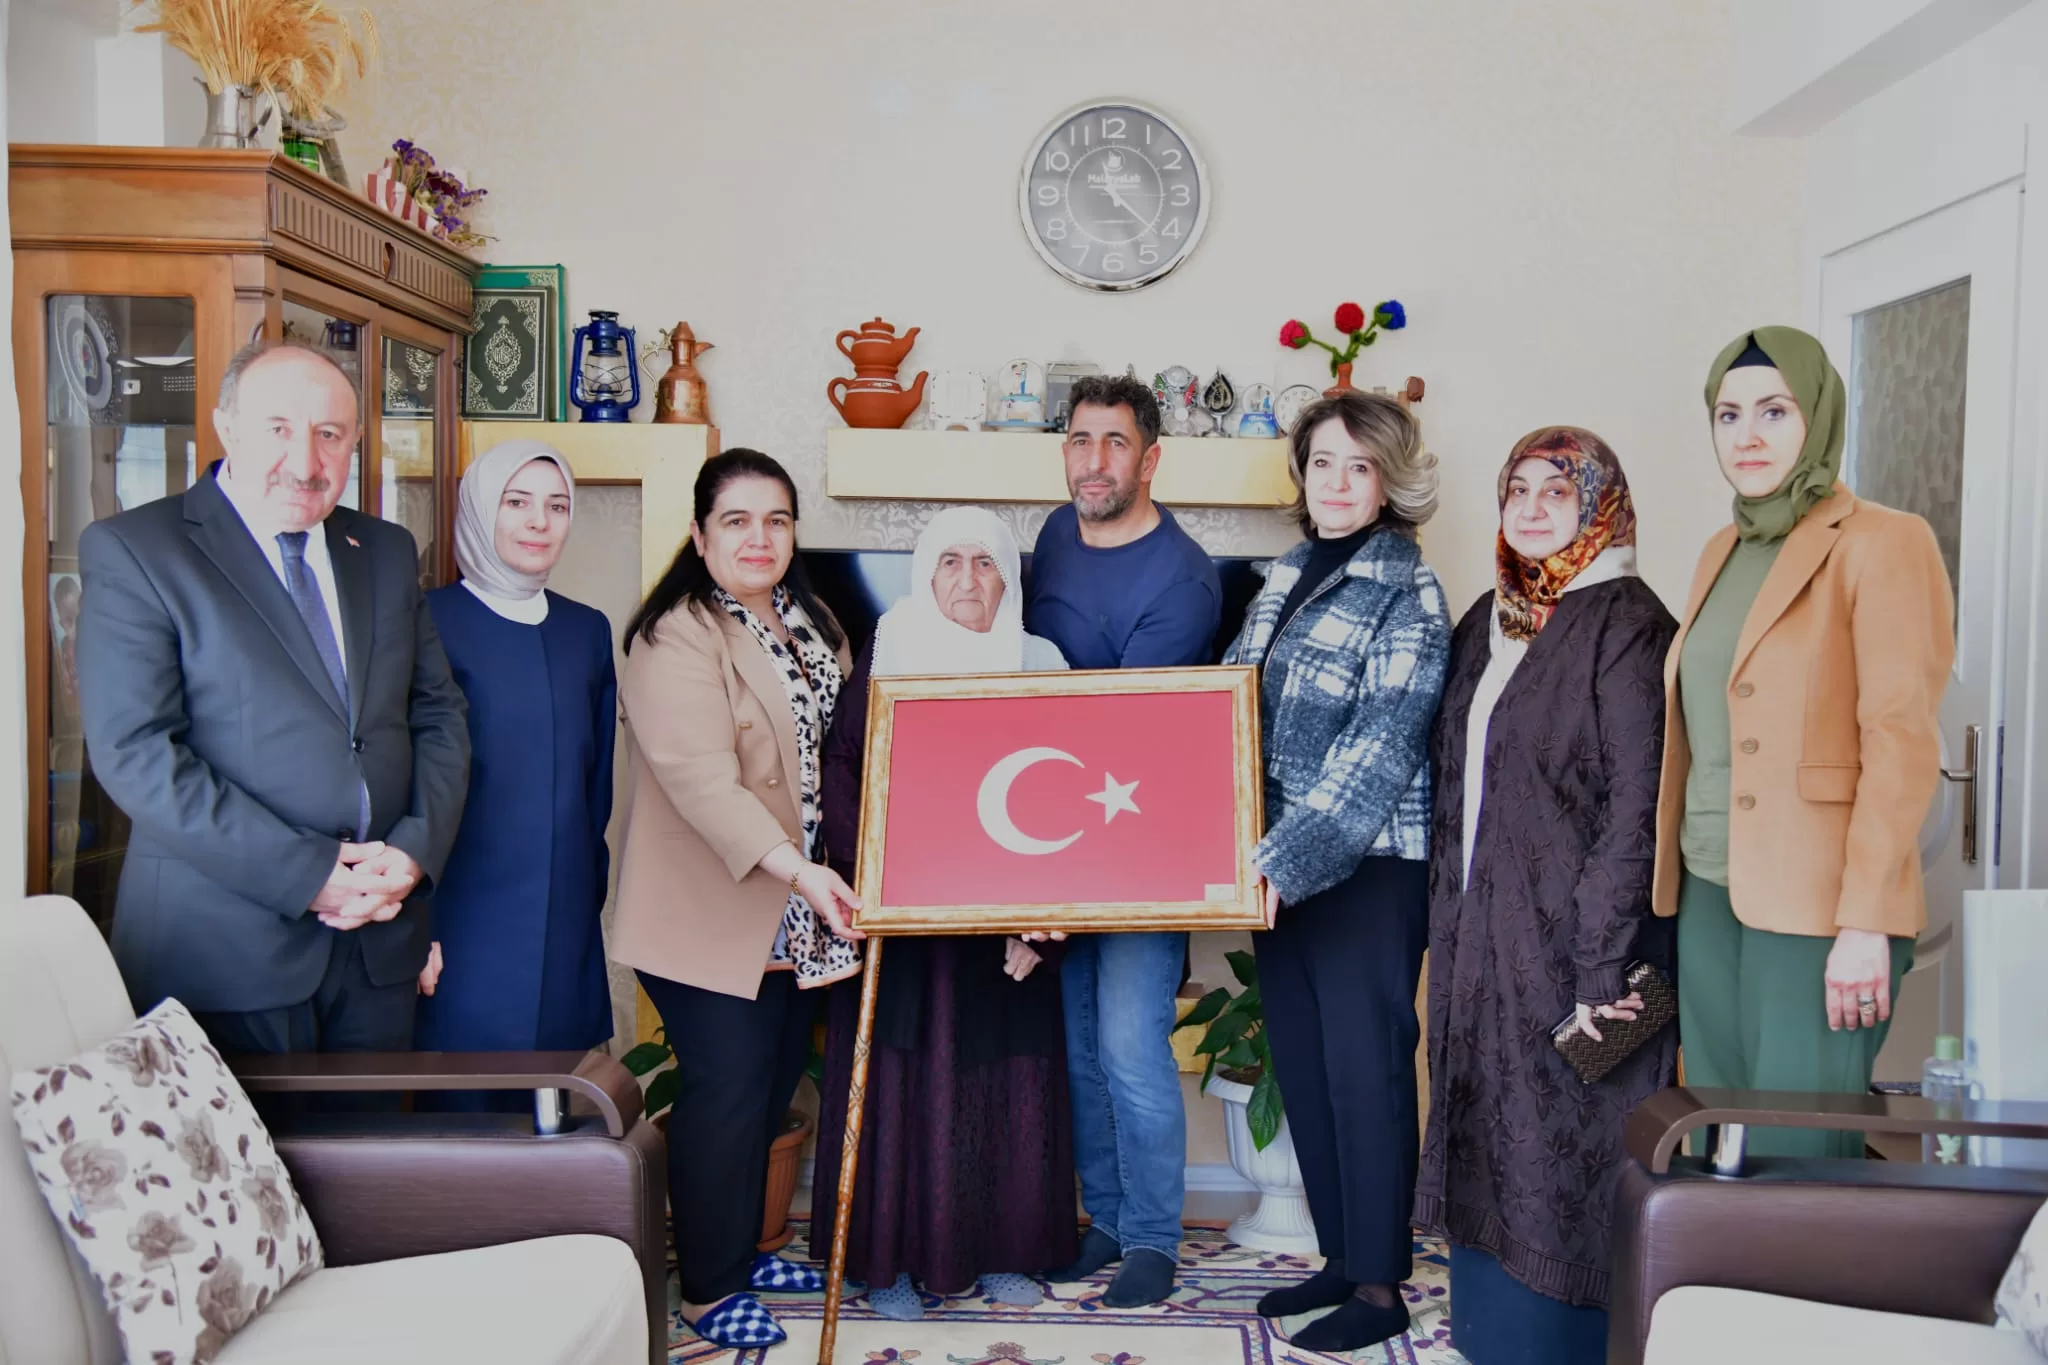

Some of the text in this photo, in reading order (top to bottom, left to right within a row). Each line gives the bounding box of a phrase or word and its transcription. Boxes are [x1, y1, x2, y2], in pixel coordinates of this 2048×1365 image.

[1070, 125, 1089, 146] 11
[1102, 117, 1127, 139] 12
[1145, 123, 1151, 145] 1
[1045, 151, 1070, 172] 10
[1161, 149, 1183, 170] 2
[1037, 185, 1060, 207] 9
[1170, 184, 1191, 206] 3
[1046, 218, 1067, 240] 8
[1161, 217, 1183, 240] 4
[1071, 244, 1090, 266] 7
[1102, 252, 1124, 273] 6
[1137, 244, 1159, 265] 5
